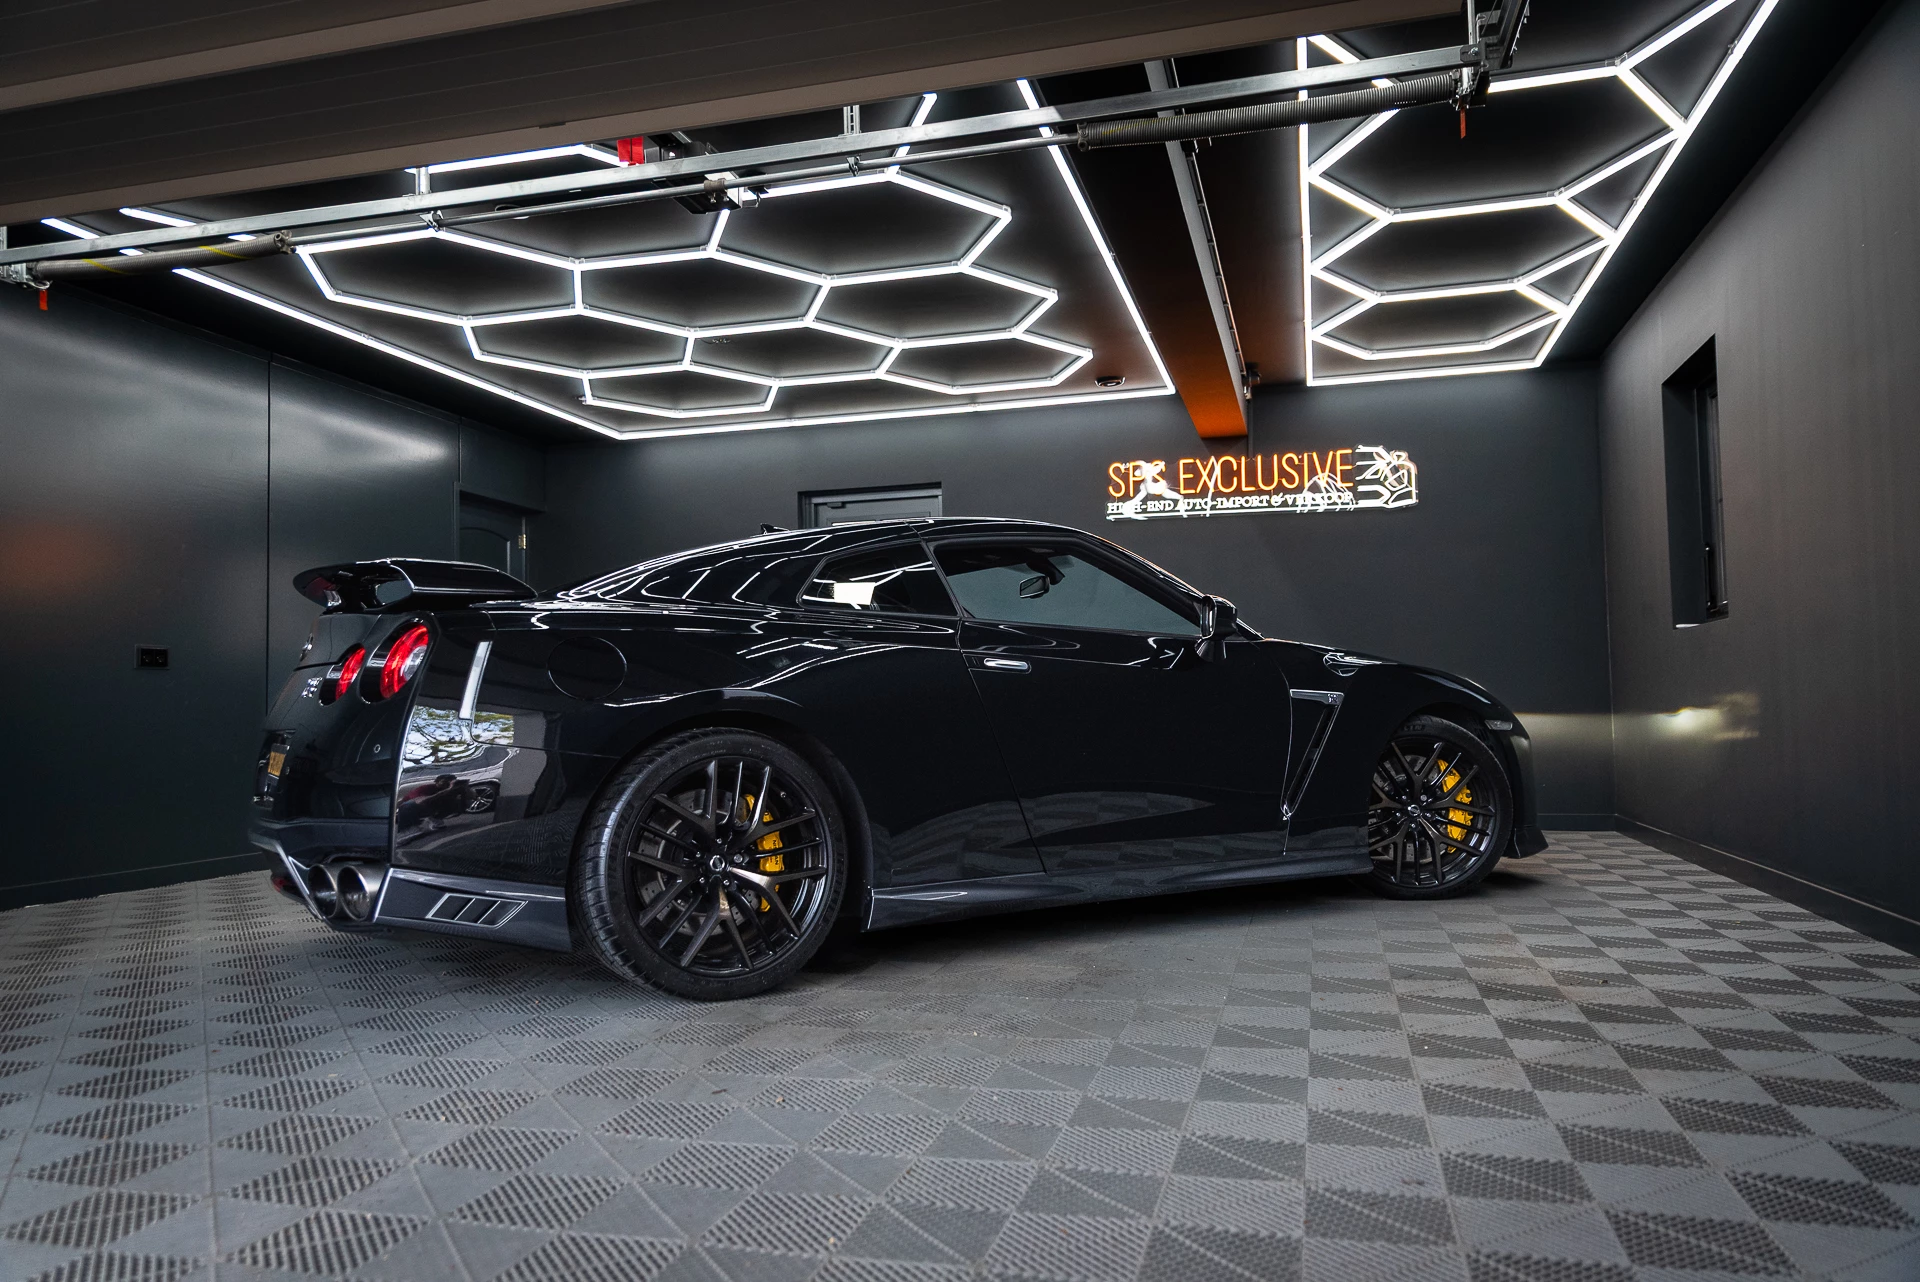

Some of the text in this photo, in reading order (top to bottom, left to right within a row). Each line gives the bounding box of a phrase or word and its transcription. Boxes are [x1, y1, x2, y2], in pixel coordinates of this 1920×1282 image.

[1178, 448, 1354, 495] EXCLUSIVE
[1106, 500, 1174, 514] HIH-END
[1271, 492, 1286, 506] &
